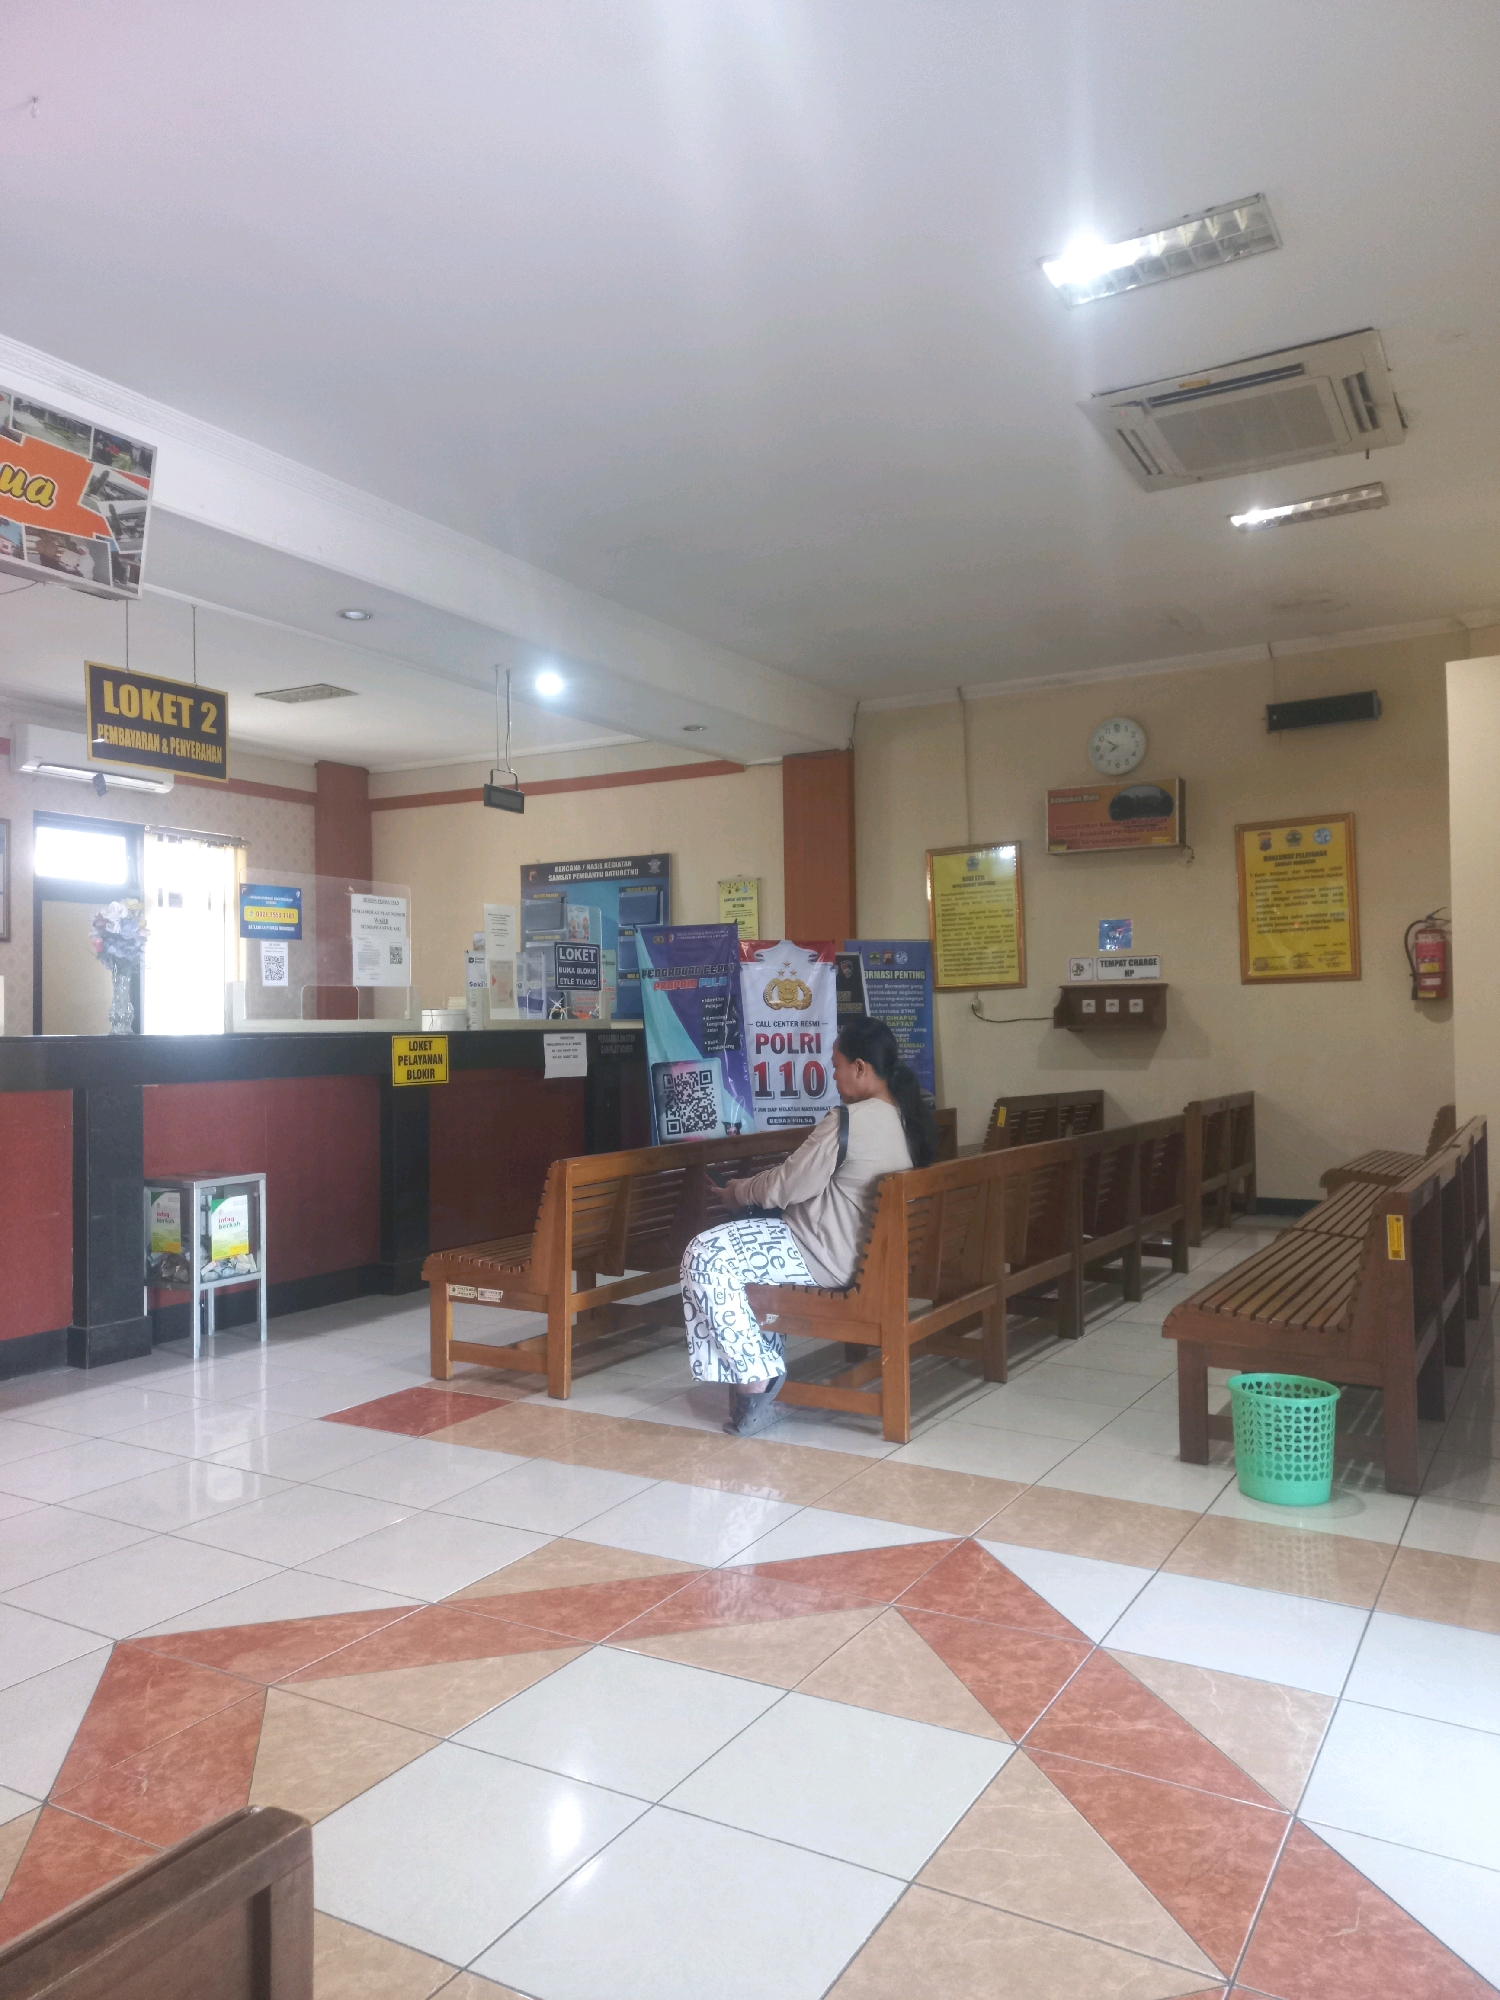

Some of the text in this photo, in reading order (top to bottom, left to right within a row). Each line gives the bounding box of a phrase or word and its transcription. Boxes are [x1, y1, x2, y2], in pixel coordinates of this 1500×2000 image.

[103, 680, 217, 734] LOKET 2
[97, 723, 222, 764] PEMBAYARAN & PENYERAHAN
[549, 874, 571, 882] SAMSAT
[572, 871, 603, 880] PEMBANTU
[560, 948, 597, 961] LOKET
[1100, 958, 1157, 967] TEMPAT CHARGE
[559, 966, 597, 975] BUKA BLOKIR
[641, 965, 700, 979] PENGADUAN
[894, 970, 926, 980] PENTING
[575, 978, 597, 986] TILANG
[653, 979, 697, 991] PROPAM
[408, 1040, 433, 1052] LOKET
[755, 1032, 822, 1055] POLRI
[397, 1053, 443, 1067] PELAYANAN
[406, 1068, 436, 1081] BLOKIR
[754, 1060, 828, 1100] 110
[218, 1216, 235, 1224] infaq
[218, 1221, 241, 1230] berkah
